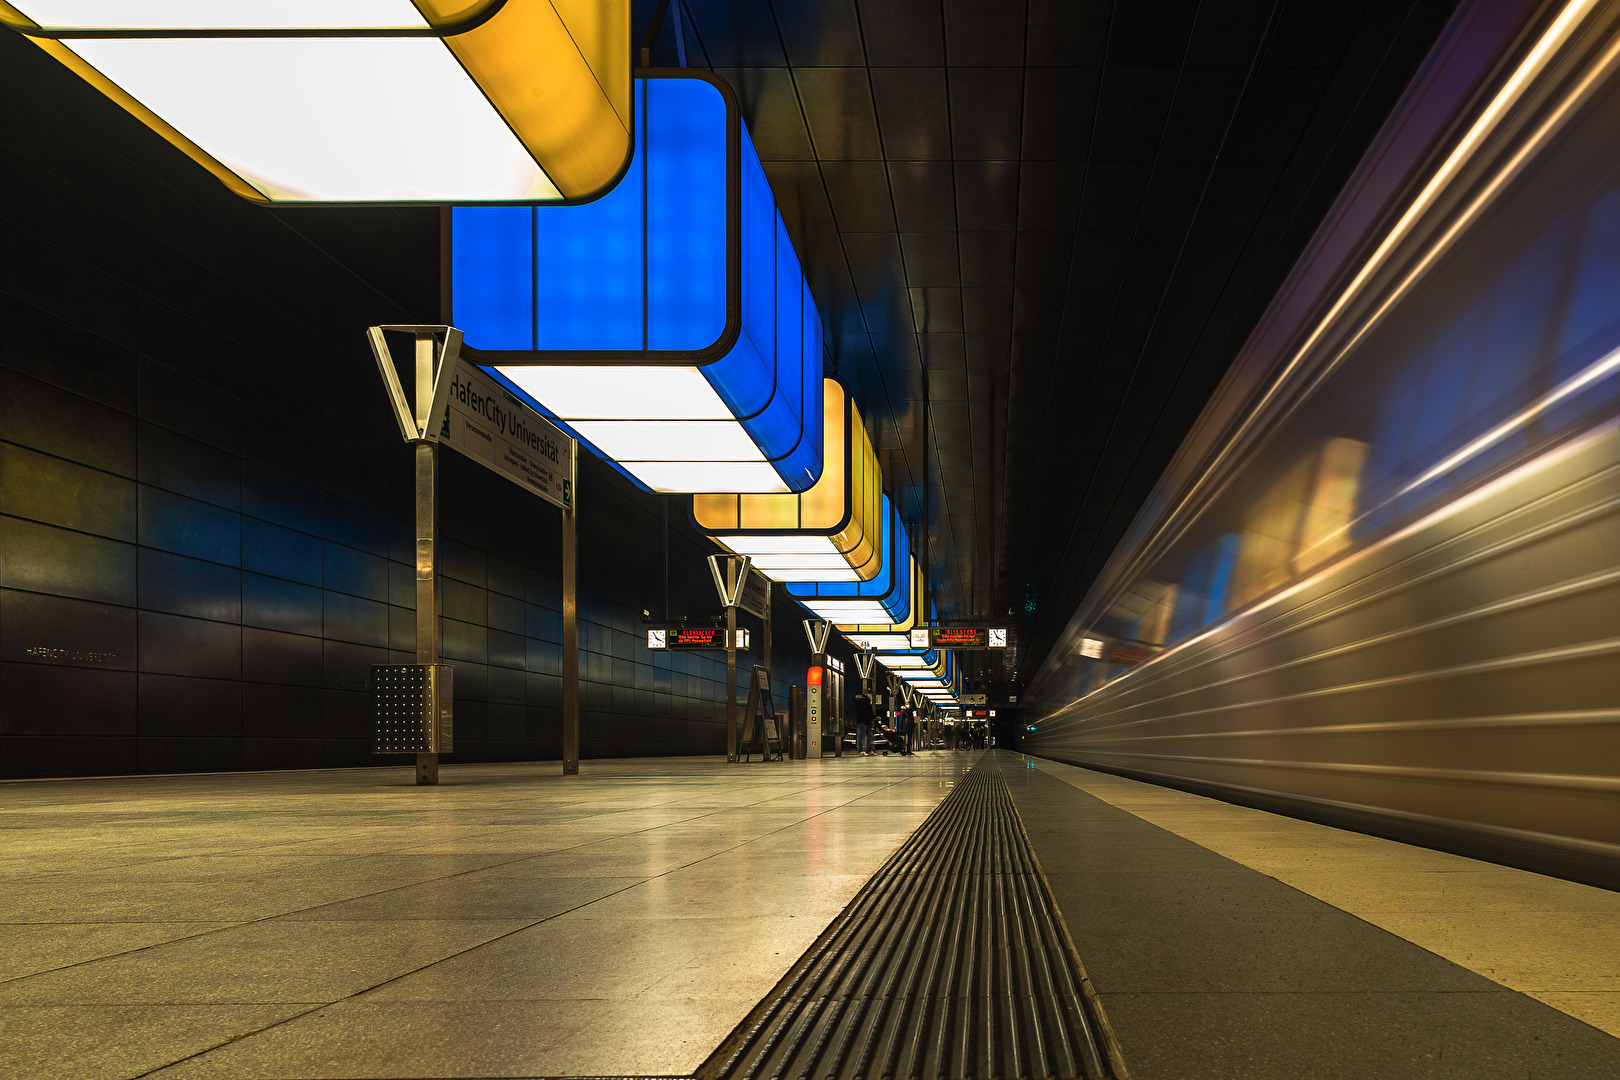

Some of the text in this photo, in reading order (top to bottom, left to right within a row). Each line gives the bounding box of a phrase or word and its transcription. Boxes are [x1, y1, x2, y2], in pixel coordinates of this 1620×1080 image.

[450, 374, 560, 465] HafenCity Universität
[26, 645, 69, 659] HAFENCTY
